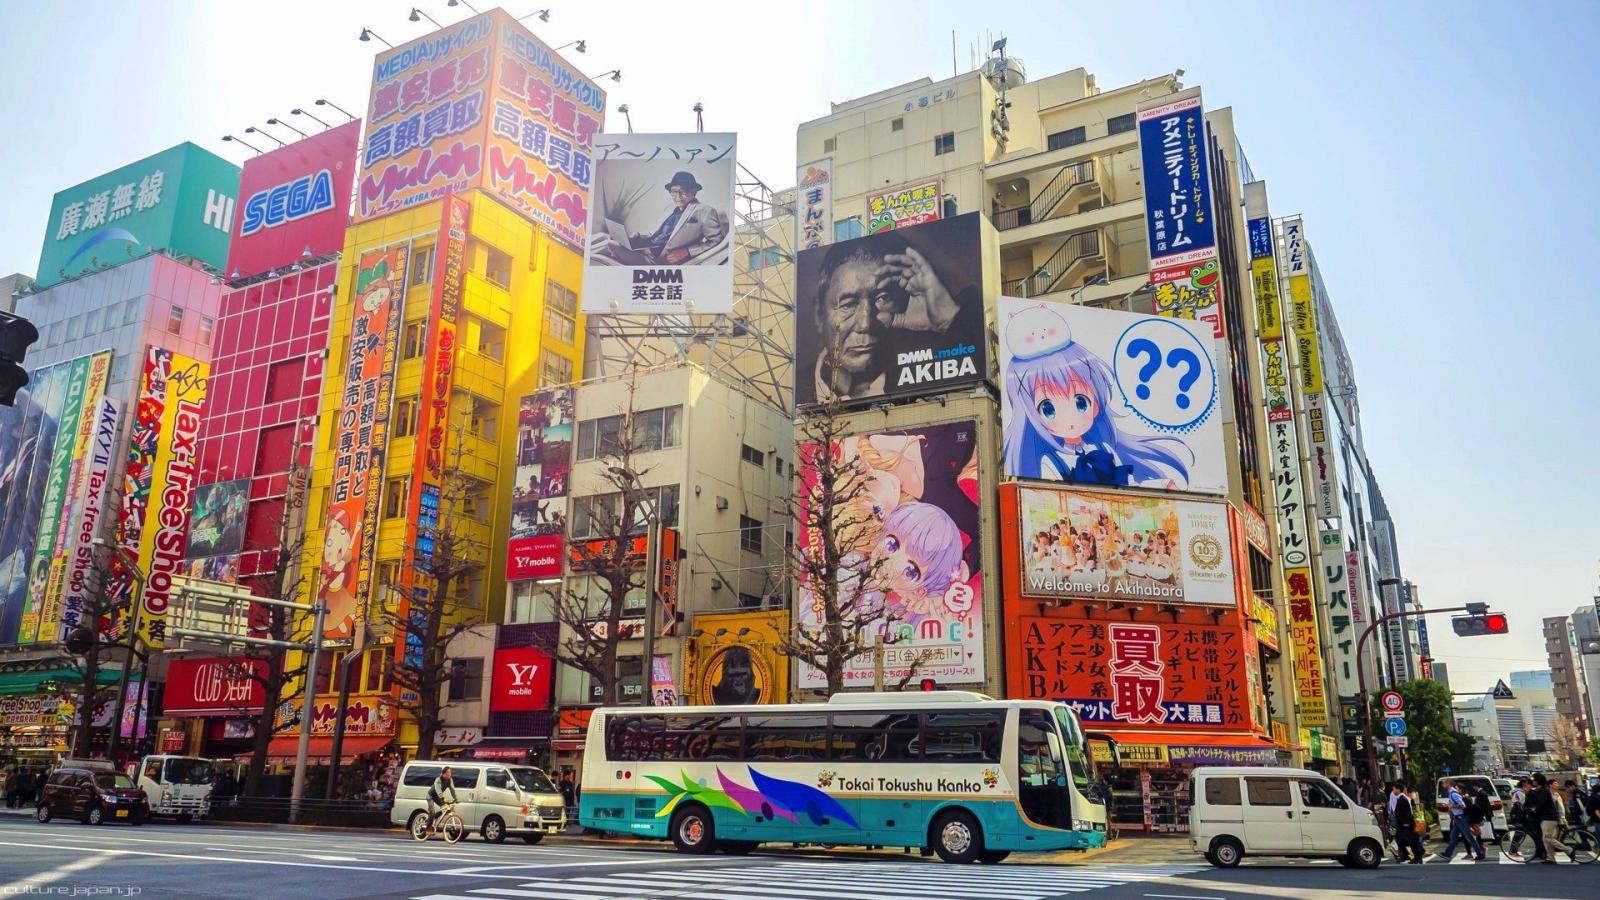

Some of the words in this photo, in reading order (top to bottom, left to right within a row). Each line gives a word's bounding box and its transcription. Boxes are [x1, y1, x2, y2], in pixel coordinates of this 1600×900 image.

[1142, 106, 1170, 118] AMENITY
[1173, 99, 1198, 111] DREAM
[364, 92, 481, 168] 高額買取
[360, 142, 482, 216] Mulan
[403, 190, 430, 205] AKIBA
[56, 169, 166, 241] 廣瀬無線
[241, 168, 336, 238] SEGA
[532, 208, 556, 228] AKIBA
[1153, 208, 1167, 251] 秋葉原店
[632, 268, 684, 284] DMM
[1155, 255, 1184, 266] AMENITY
[1187, 249, 1213, 261] DREAM
[631, 284, 683, 301] 英会話
[1294, 301, 1306, 331] Yellow
[897, 356, 977, 386] AKIBA
[98, 399, 117, 455] AKKY
[333, 316, 369, 504] 激安販売の専門店
[352, 377, 379, 498] 高額買取と
[159, 400, 206, 528] Tax-free
[293, 471, 307, 509] GAME
[144, 528, 184, 614] Shop
[1029, 576, 1093, 593] Welcome
[1096, 579, 1110, 593] to
[1115, 581, 1184, 598] Akihabara
[1305, 626, 1317, 656] TAX
[1326, 564, 1353, 680] リバティー
[1050, 623, 1069, 694] アイドル
[1068, 623, 1087, 676] アニメ
[1087, 624, 1108, 698] 美少女系
[1165, 628, 1185, 700] フィギュア
[1183, 629, 1200, 680] ホビー
[1201, 629, 1223, 702] 携帯電話
[194, 663, 221, 702] CLUB
[508, 688, 533, 696] mobile
[1110, 624, 1165, 723] 買取
[1220, 630, 1243, 725] アップルとか
[1309, 659, 1323, 698] FREE
[0, 700, 17, 711] ree
[18, 698, 41, 711] Shop
[1066, 703, 1109, 720] ケット
[1170, 703, 1222, 723] 大黒屋
[1388, 696, 1399, 706] 40
[439, 730, 477, 744] ラーメン
[1389, 723, 1398, 734] P
[838, 777, 875, 791] Tokai
[877, 778, 933, 792] Tokushu
[937, 778, 982, 793] Kanko
